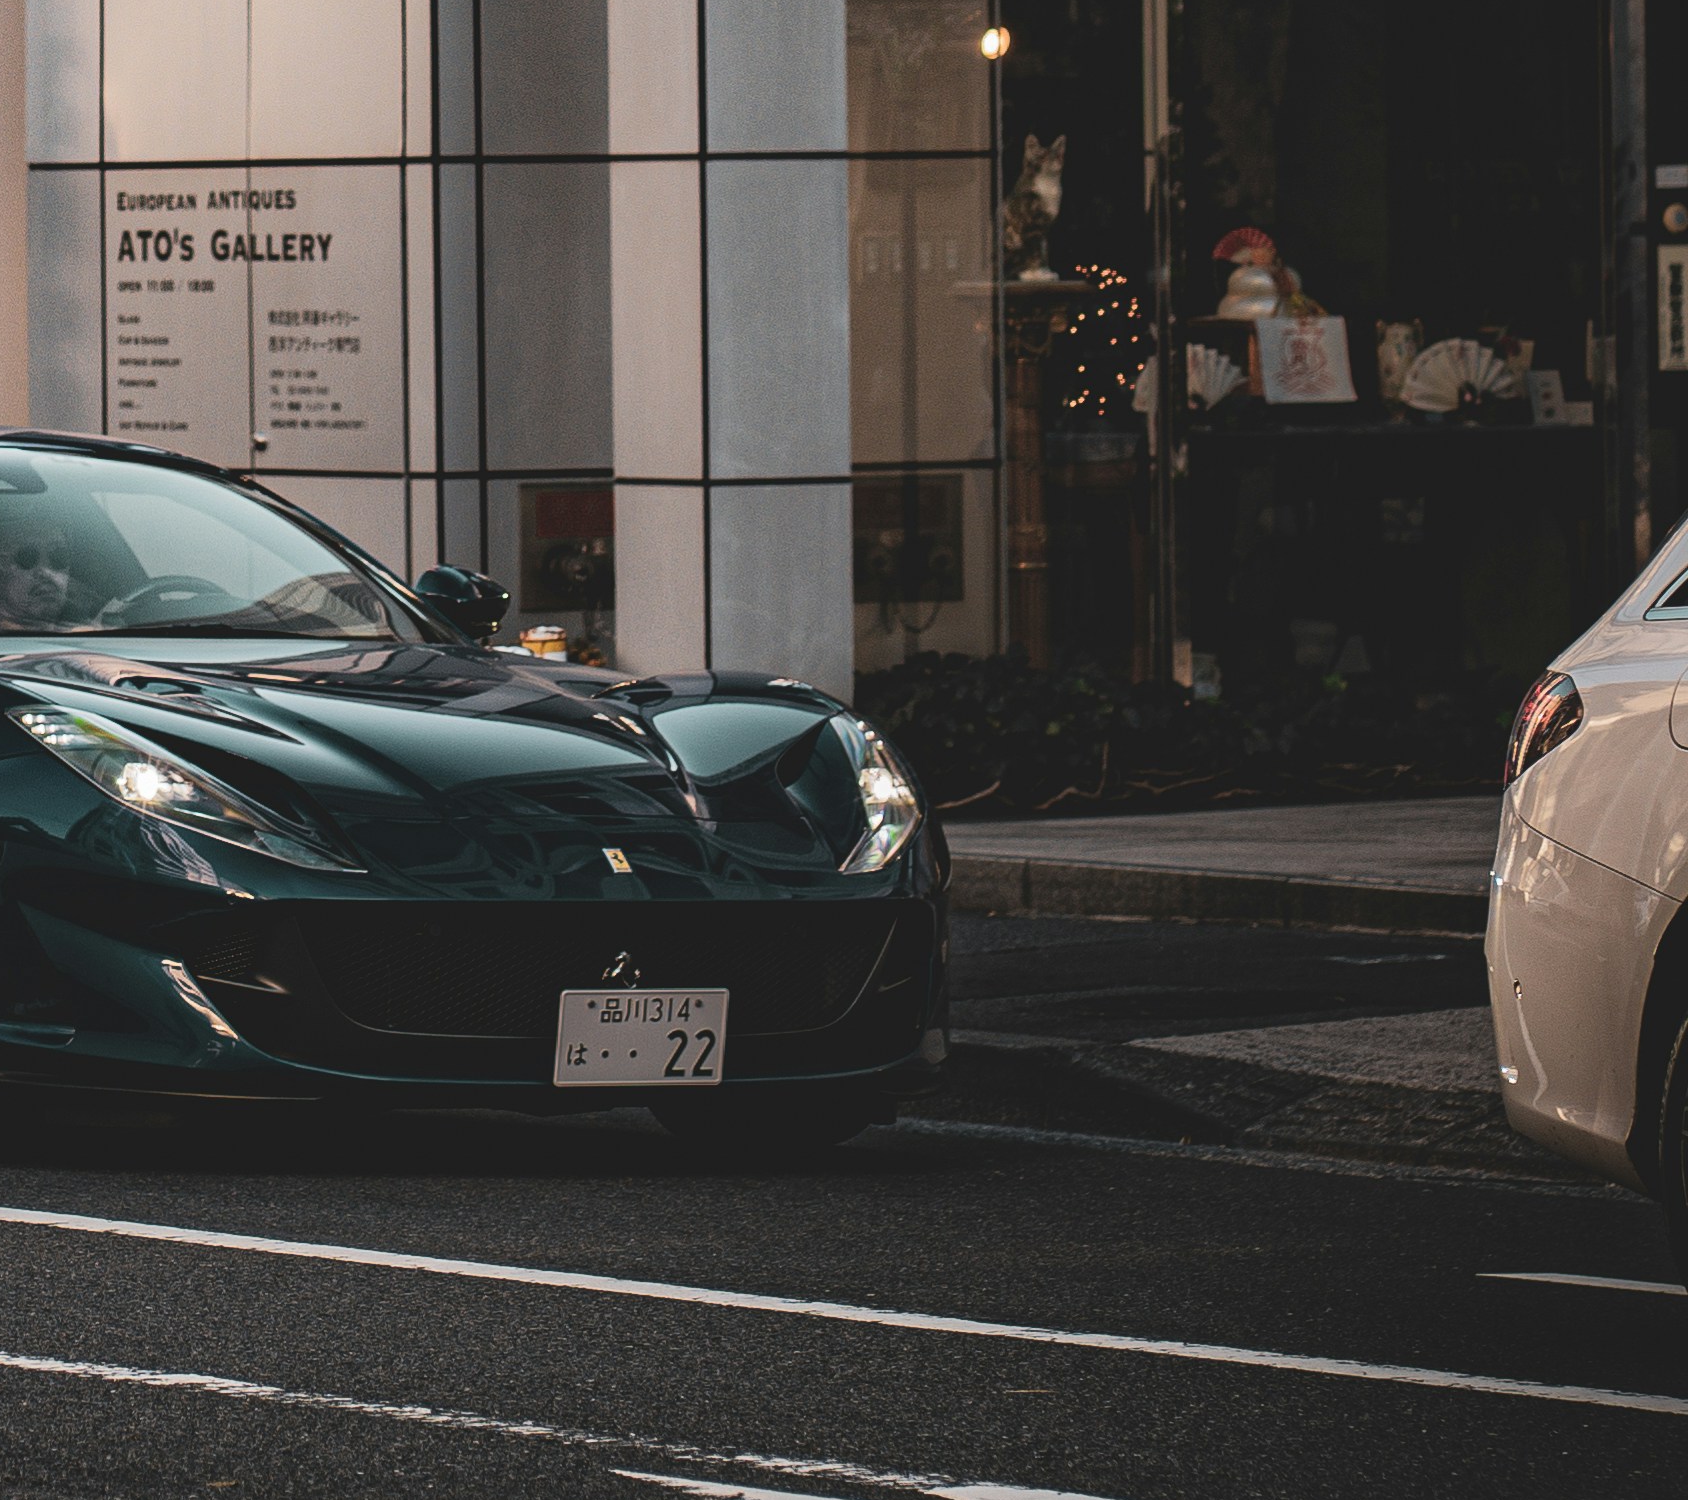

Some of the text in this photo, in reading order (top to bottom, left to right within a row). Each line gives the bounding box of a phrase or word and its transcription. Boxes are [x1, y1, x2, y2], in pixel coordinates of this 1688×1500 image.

[207, 189, 296, 210] ANTIQUES
[566, 1042, 588, 1066] は
[664, 1029, 717, 1078] 22
